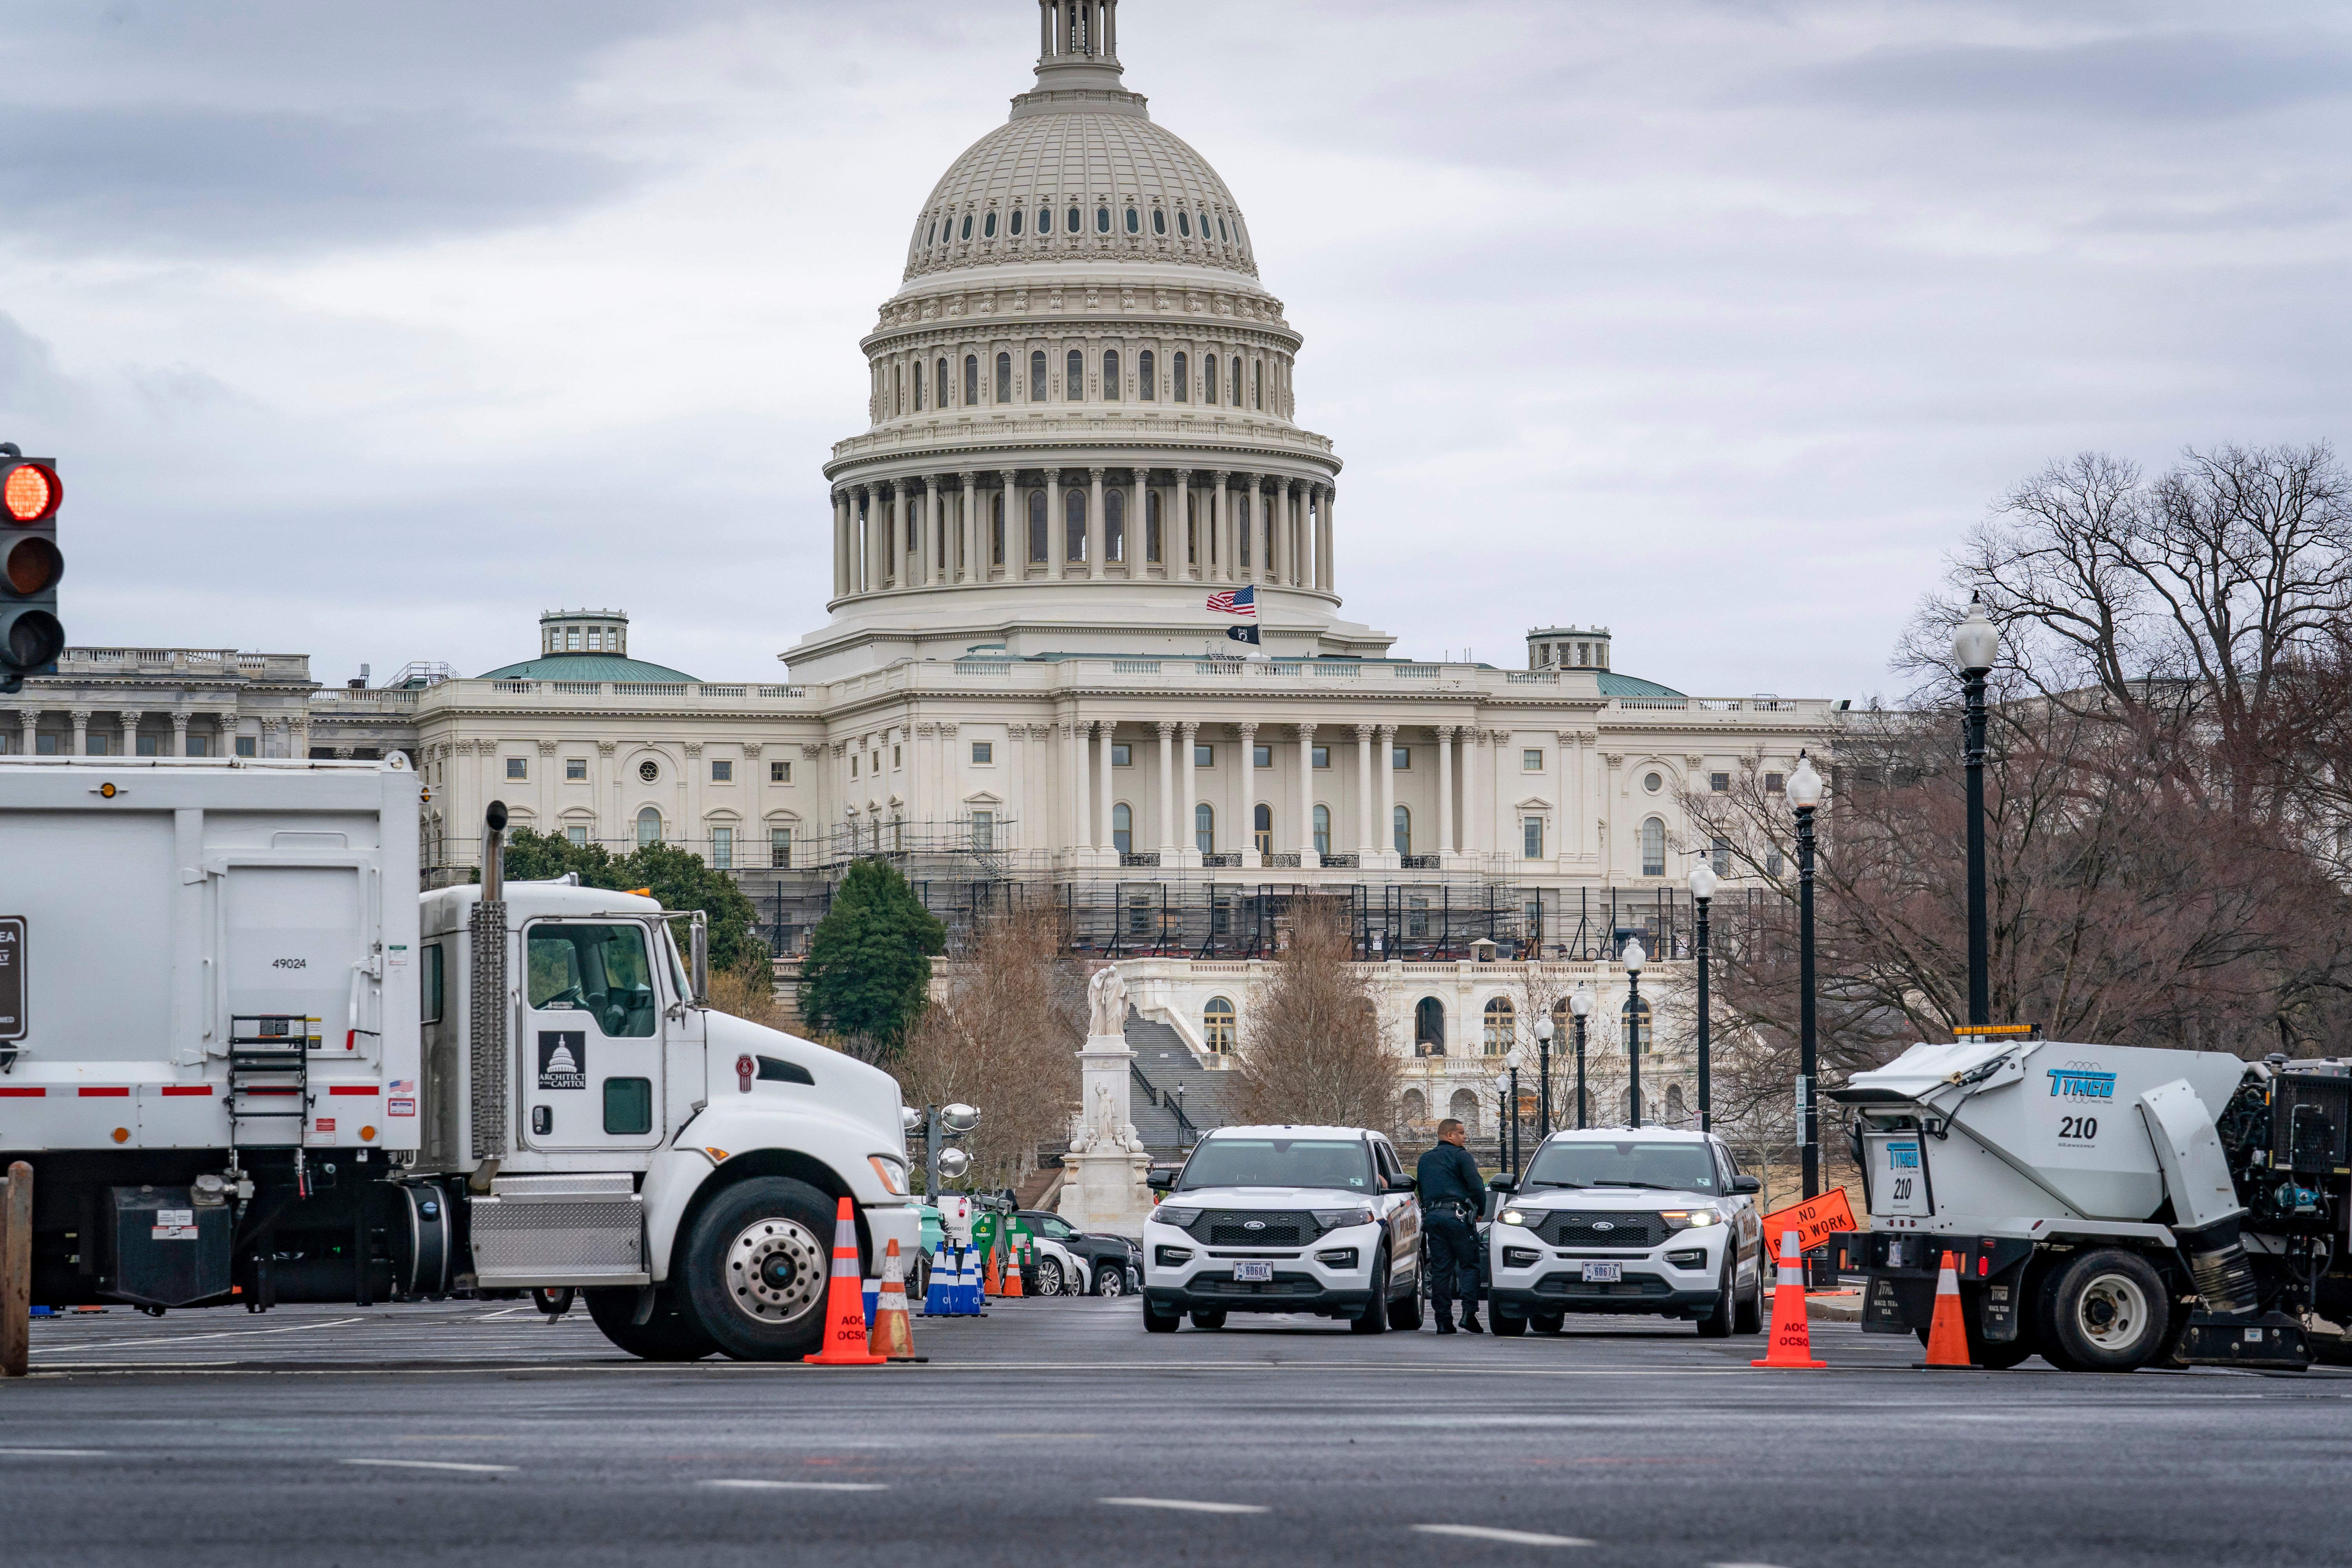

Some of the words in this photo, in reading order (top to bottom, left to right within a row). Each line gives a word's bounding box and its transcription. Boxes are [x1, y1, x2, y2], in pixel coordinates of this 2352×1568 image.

[272, 959, 306, 968] 49024
[2047, 1069, 2117, 1098] TYMCO
[2058, 1116, 2097, 1139] 210
[1886, 1142, 1918, 1170] TYMCO
[1893, 1178, 1912, 1200] 210
[1773, 1230, 1806, 1251] RD
[1809, 1214, 1847, 1237] WORK
[1246, 1266, 1267, 1276] 6068X
[1595, 1267, 1617, 1276] 6067X
[841, 1316, 863, 1325] AOC
[1784, 1323, 1806, 1332] AOC
